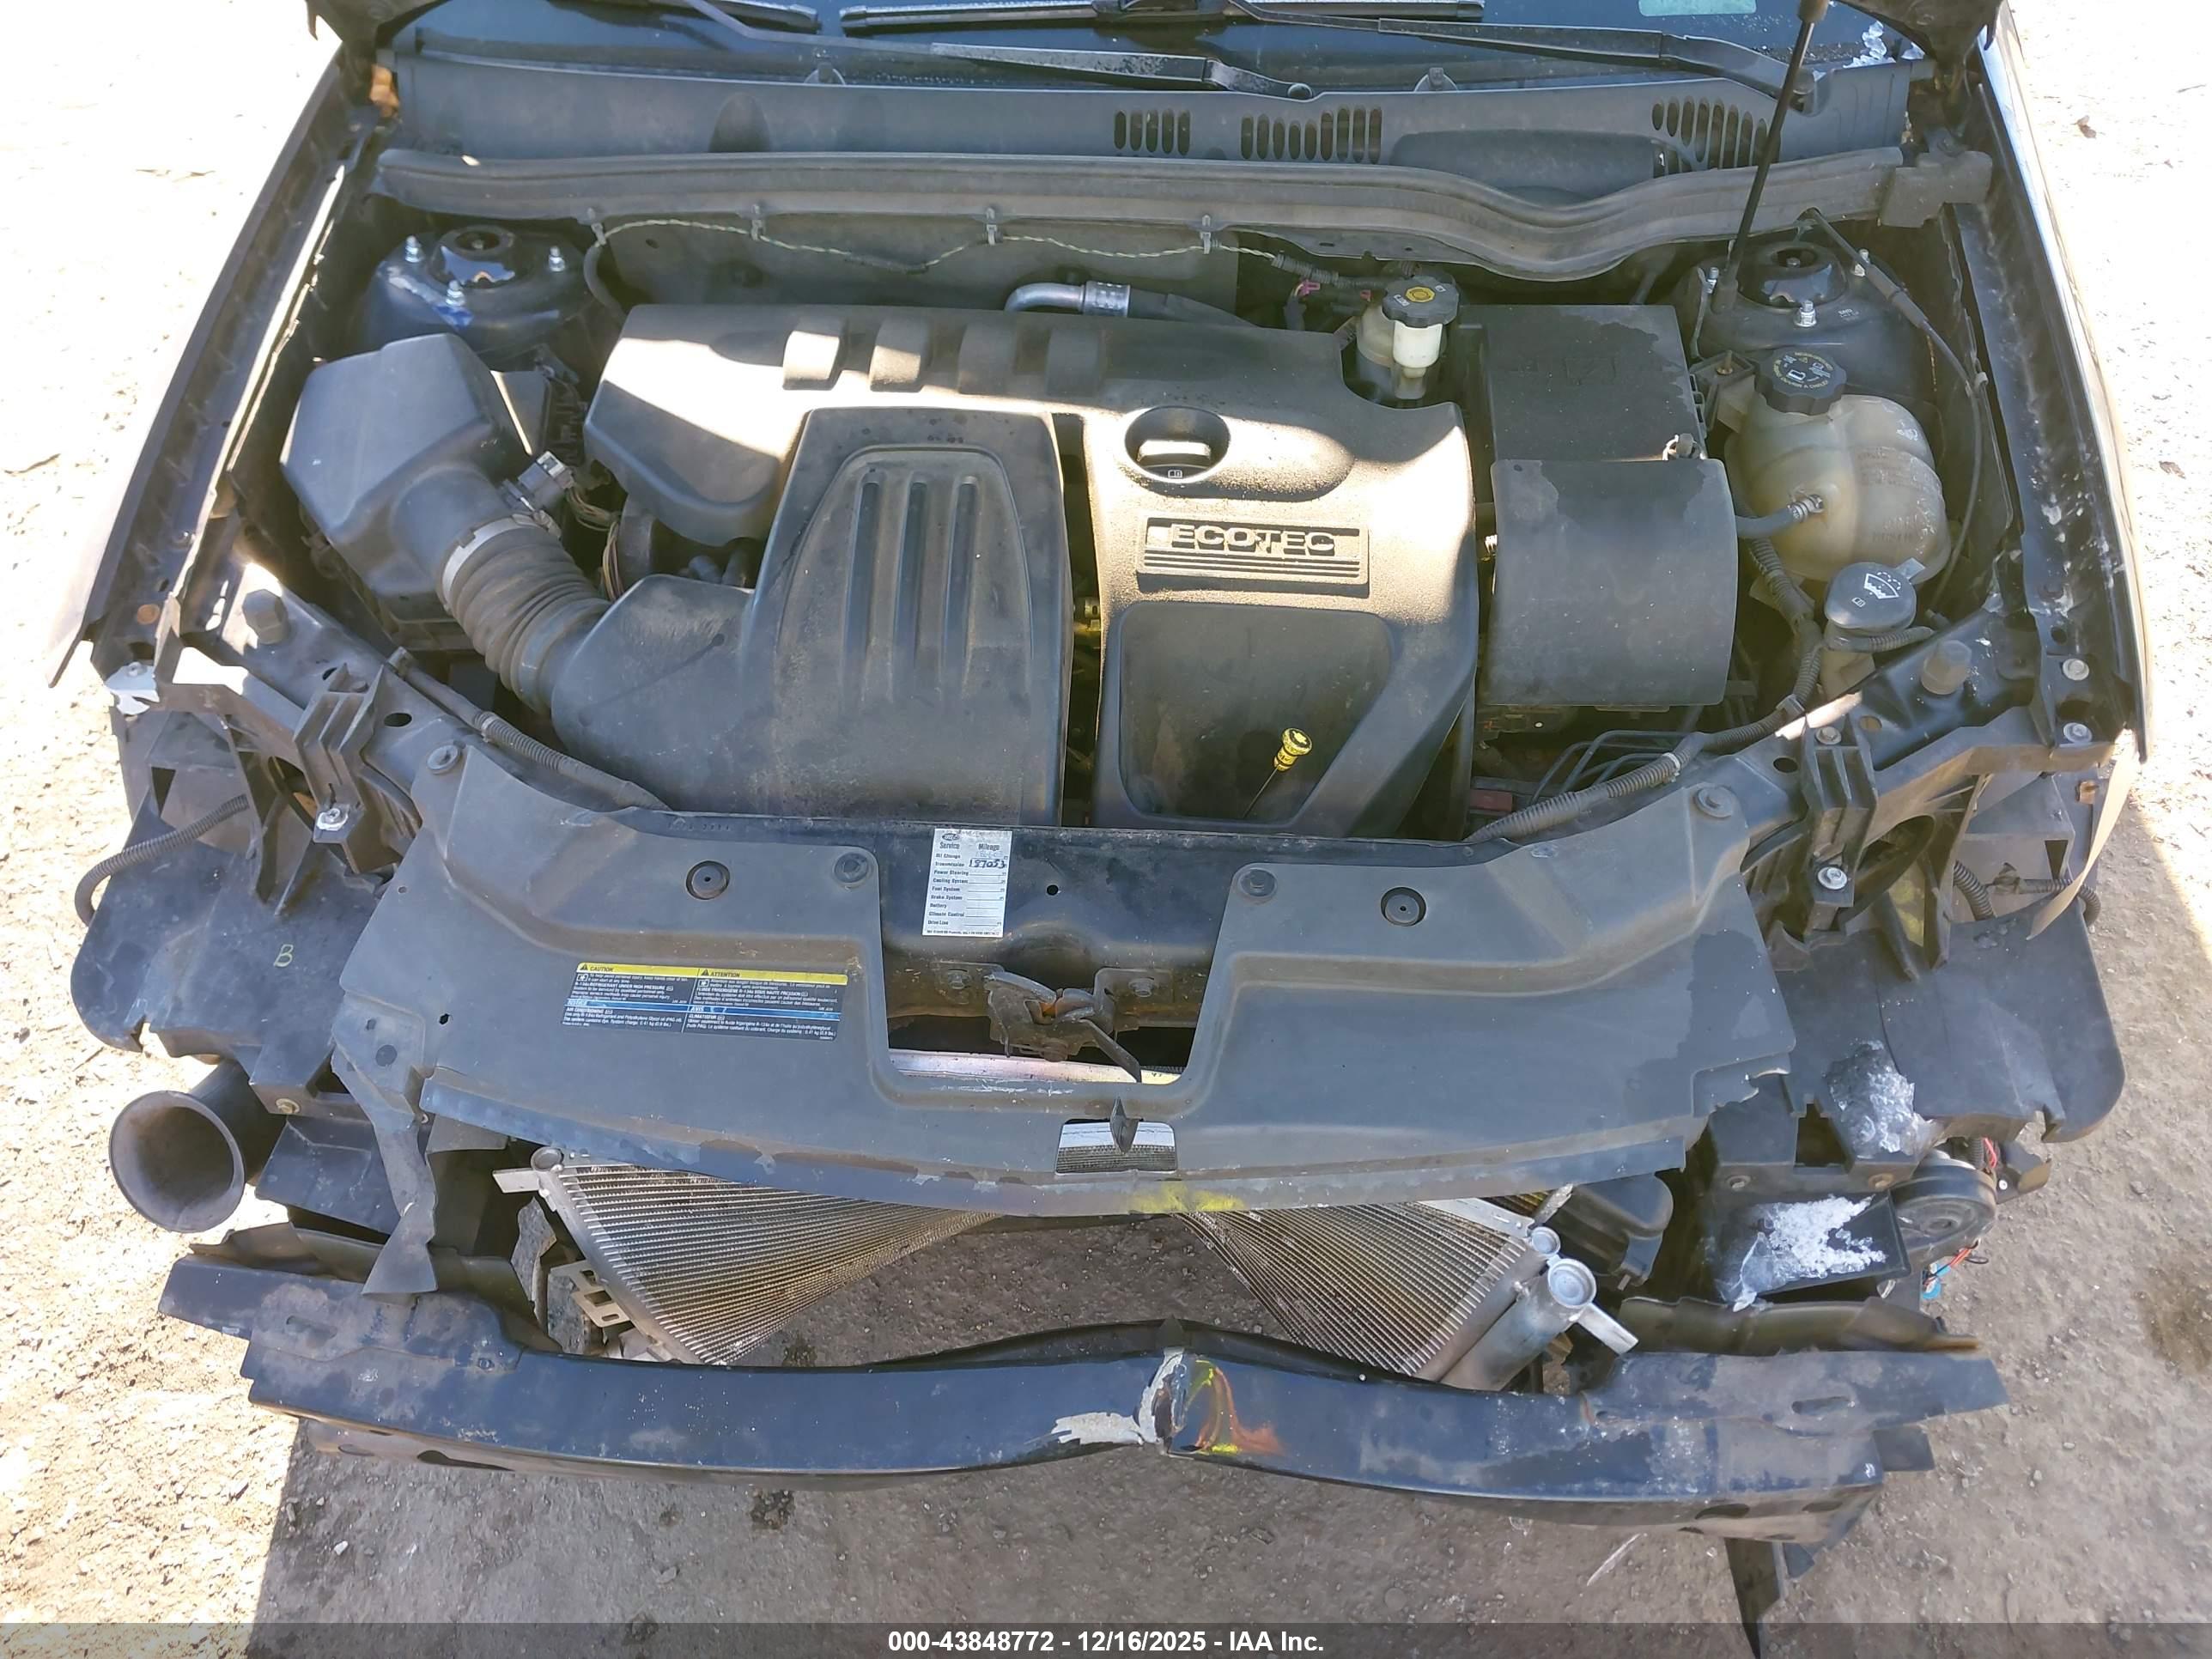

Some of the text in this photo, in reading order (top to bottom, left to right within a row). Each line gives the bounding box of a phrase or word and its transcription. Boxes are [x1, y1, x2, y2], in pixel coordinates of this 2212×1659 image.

[1170, 523, 1335, 553] ECOTEC
[978, 843, 1000, 852] Mileage
[273, 943, 295, 968] B
